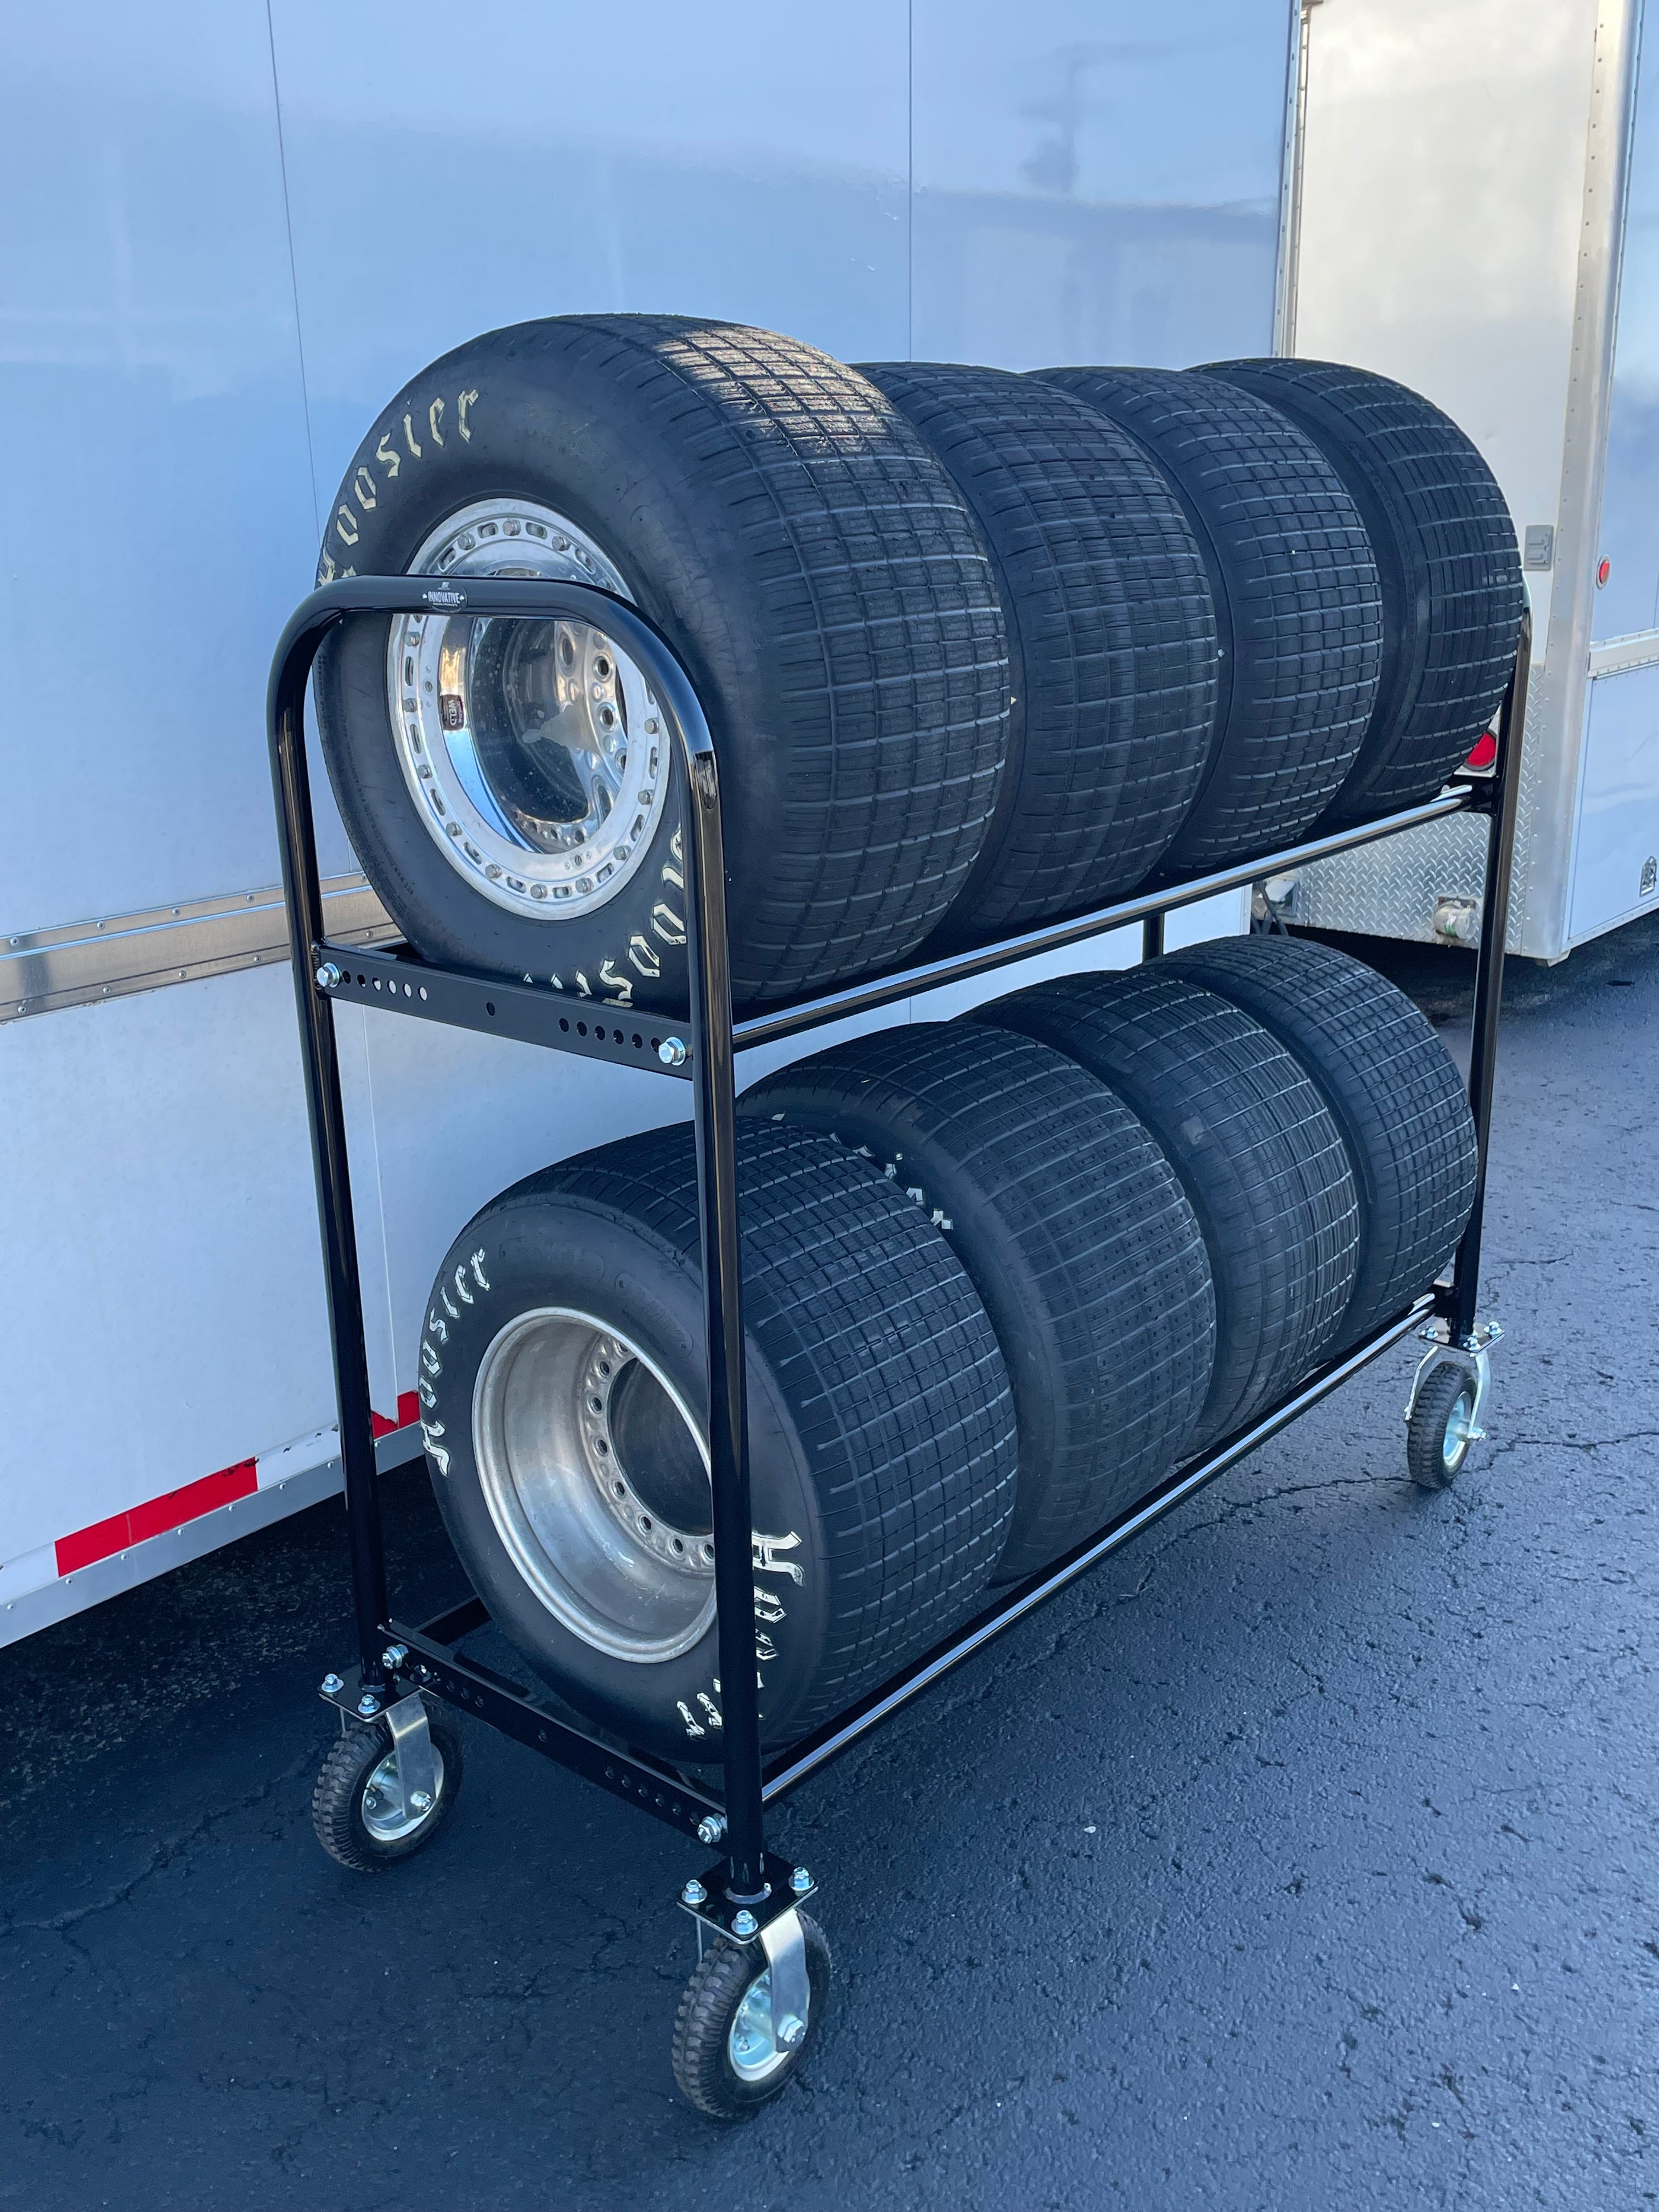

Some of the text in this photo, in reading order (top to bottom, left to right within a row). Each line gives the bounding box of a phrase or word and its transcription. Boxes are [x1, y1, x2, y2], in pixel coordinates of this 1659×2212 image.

[428, 591, 460, 603] INNOVATIVE
[448, 699, 457, 726] WELD
[523, 823, 687, 1001] oosi
[419, 1247, 490, 1477] Hoosier
[676, 1531, 805, 1741] Hooer
